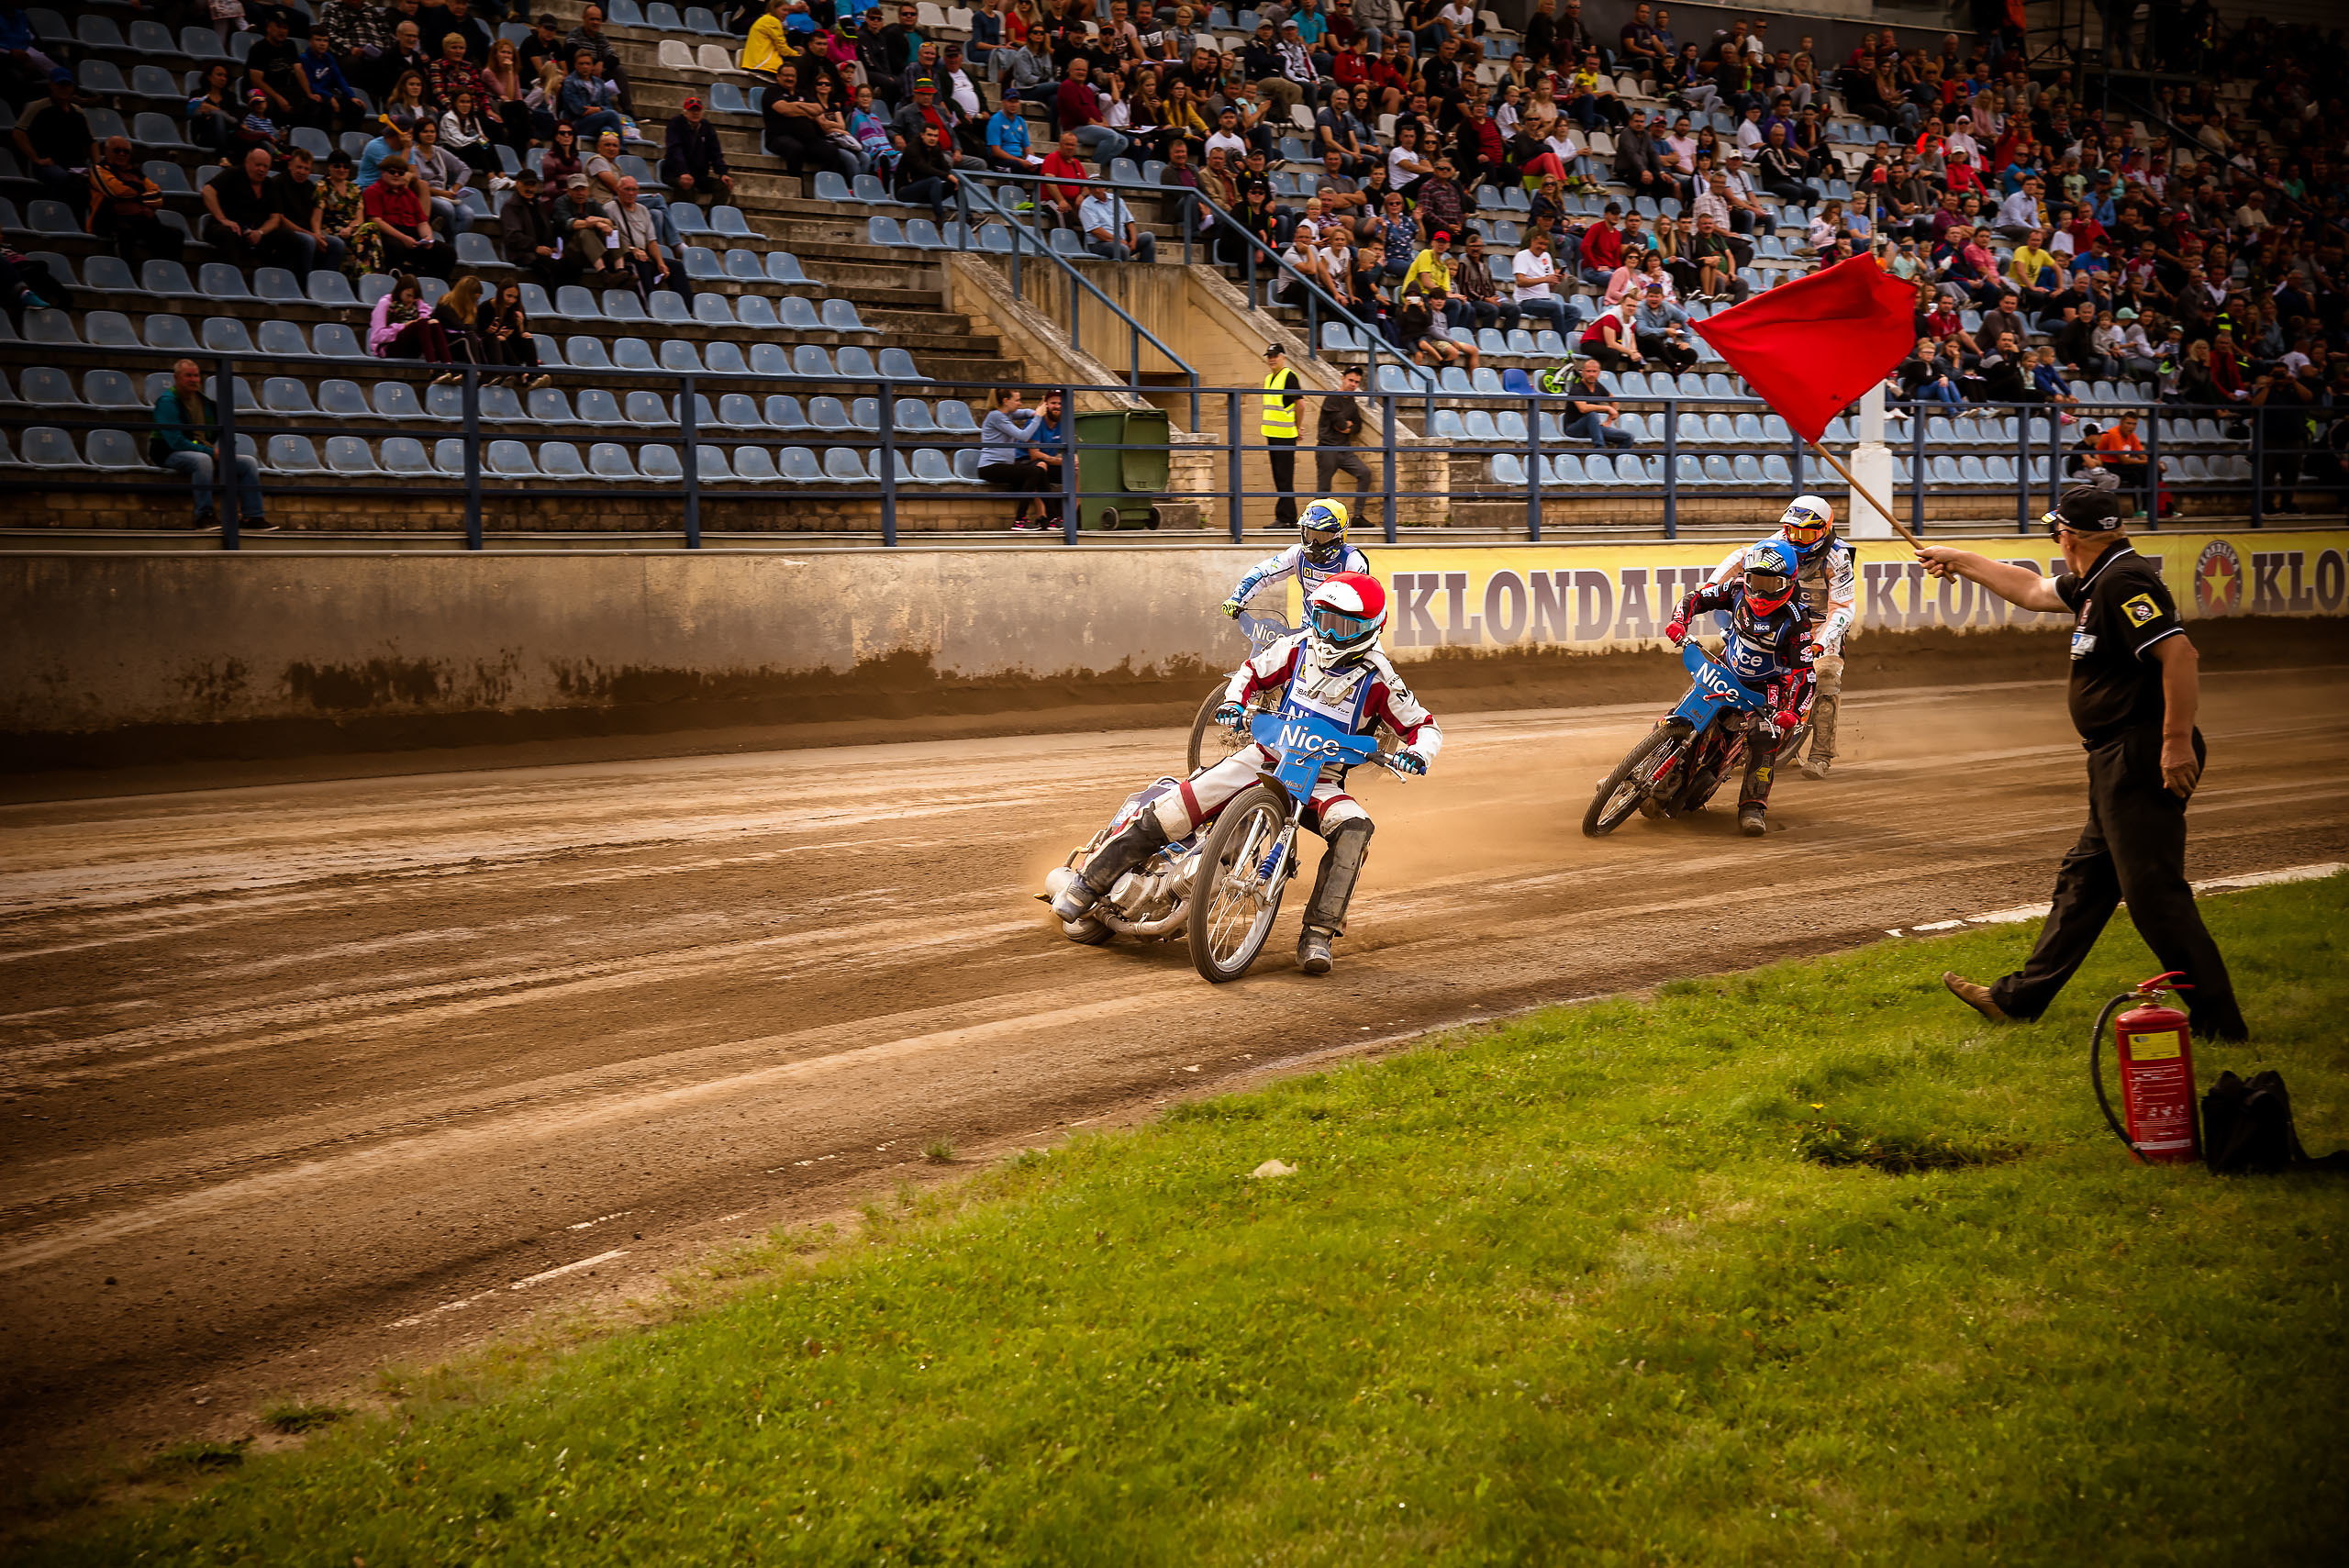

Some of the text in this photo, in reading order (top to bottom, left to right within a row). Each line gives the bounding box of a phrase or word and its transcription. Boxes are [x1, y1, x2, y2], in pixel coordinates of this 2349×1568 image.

[2251, 549, 2349, 613] KLO
[1753, 623, 1770, 632] Nice
[1732, 635, 1763, 667] Nice
[1695, 662, 1741, 704] Nice
[1277, 724, 1341, 757] Nice
